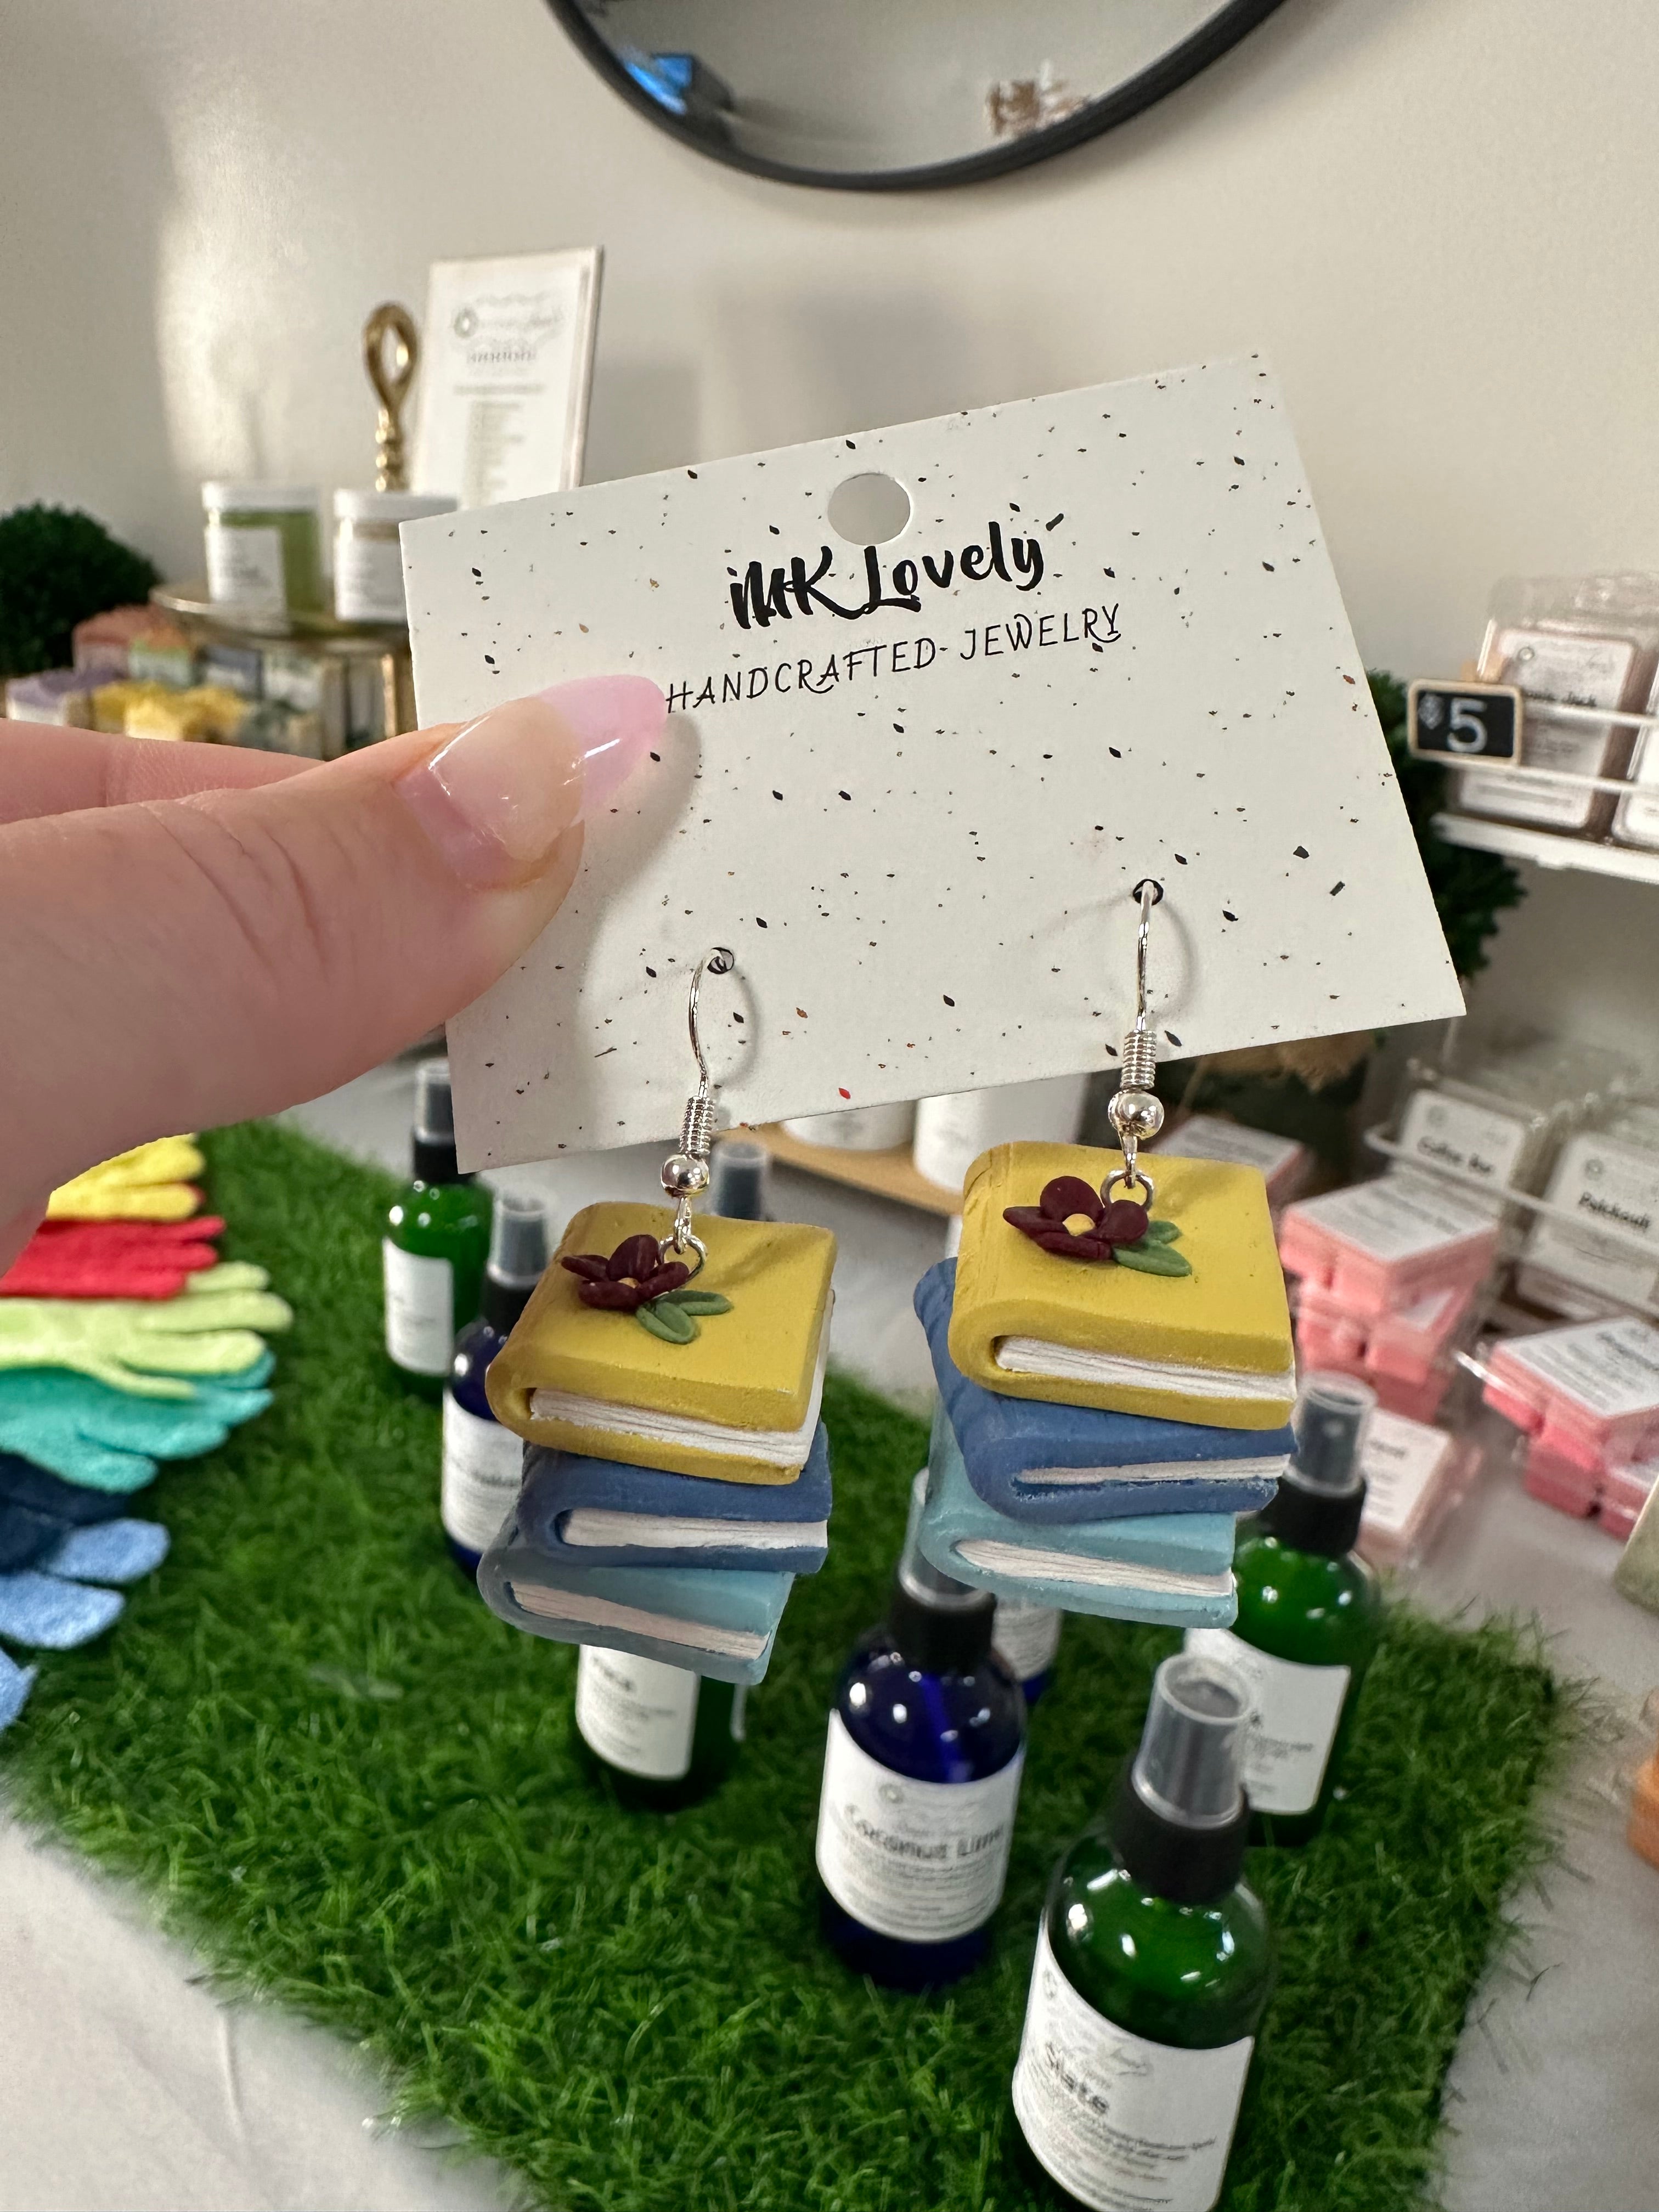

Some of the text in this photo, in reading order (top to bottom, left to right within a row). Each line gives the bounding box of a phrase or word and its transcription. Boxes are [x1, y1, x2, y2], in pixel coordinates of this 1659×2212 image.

[730, 521, 1044, 629] MK Lovely
[665, 603, 1122, 714] HANDCRAFTED JEWELRY
